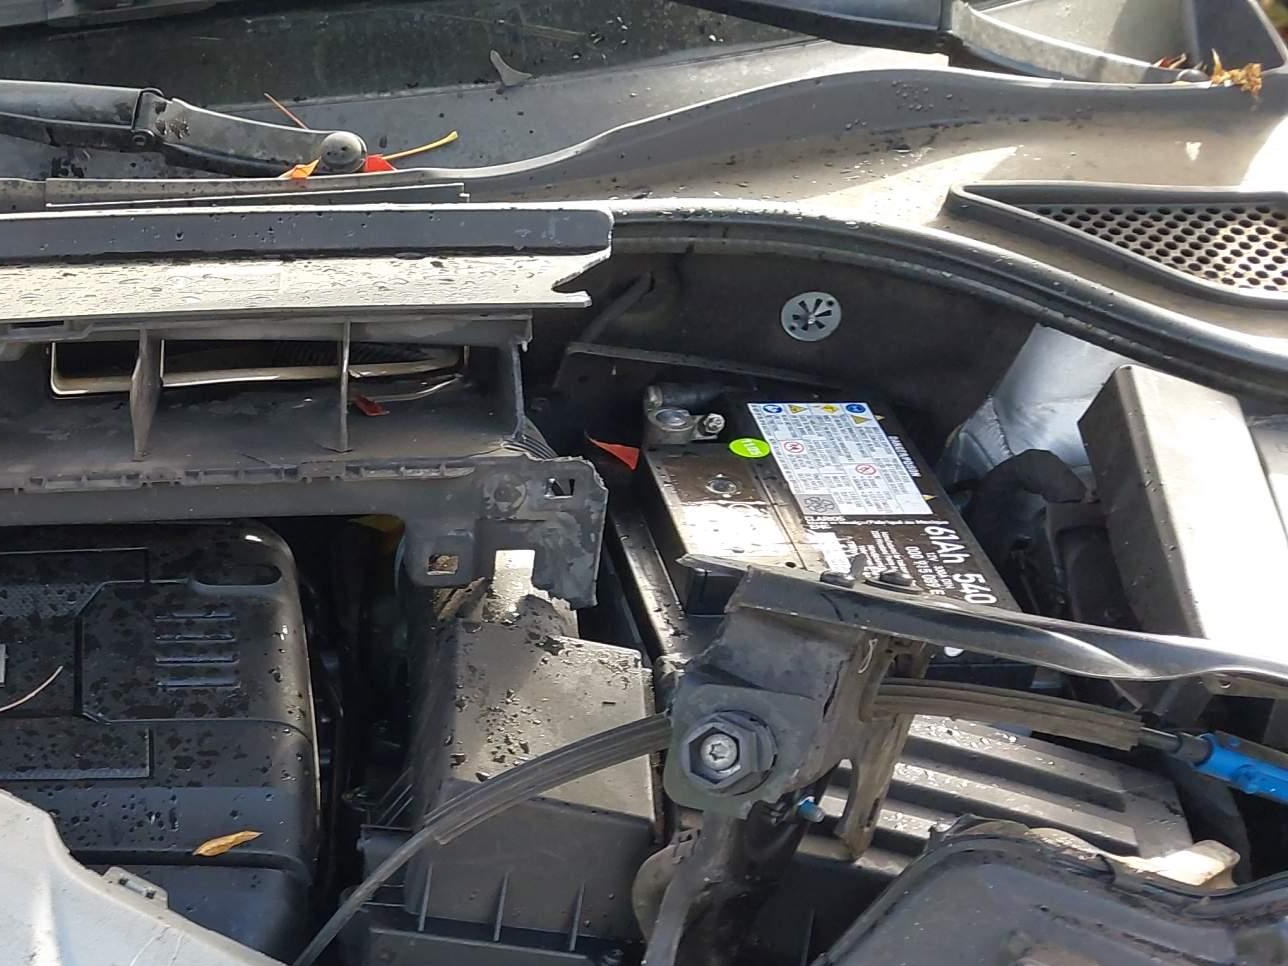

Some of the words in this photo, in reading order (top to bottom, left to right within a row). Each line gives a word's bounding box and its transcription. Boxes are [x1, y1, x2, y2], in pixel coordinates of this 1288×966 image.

[905, 546, 924, 559] 000
[913, 560, 933, 573] 915
[924, 525, 971, 564] 61Ah
[952, 572, 997, 604] 540
